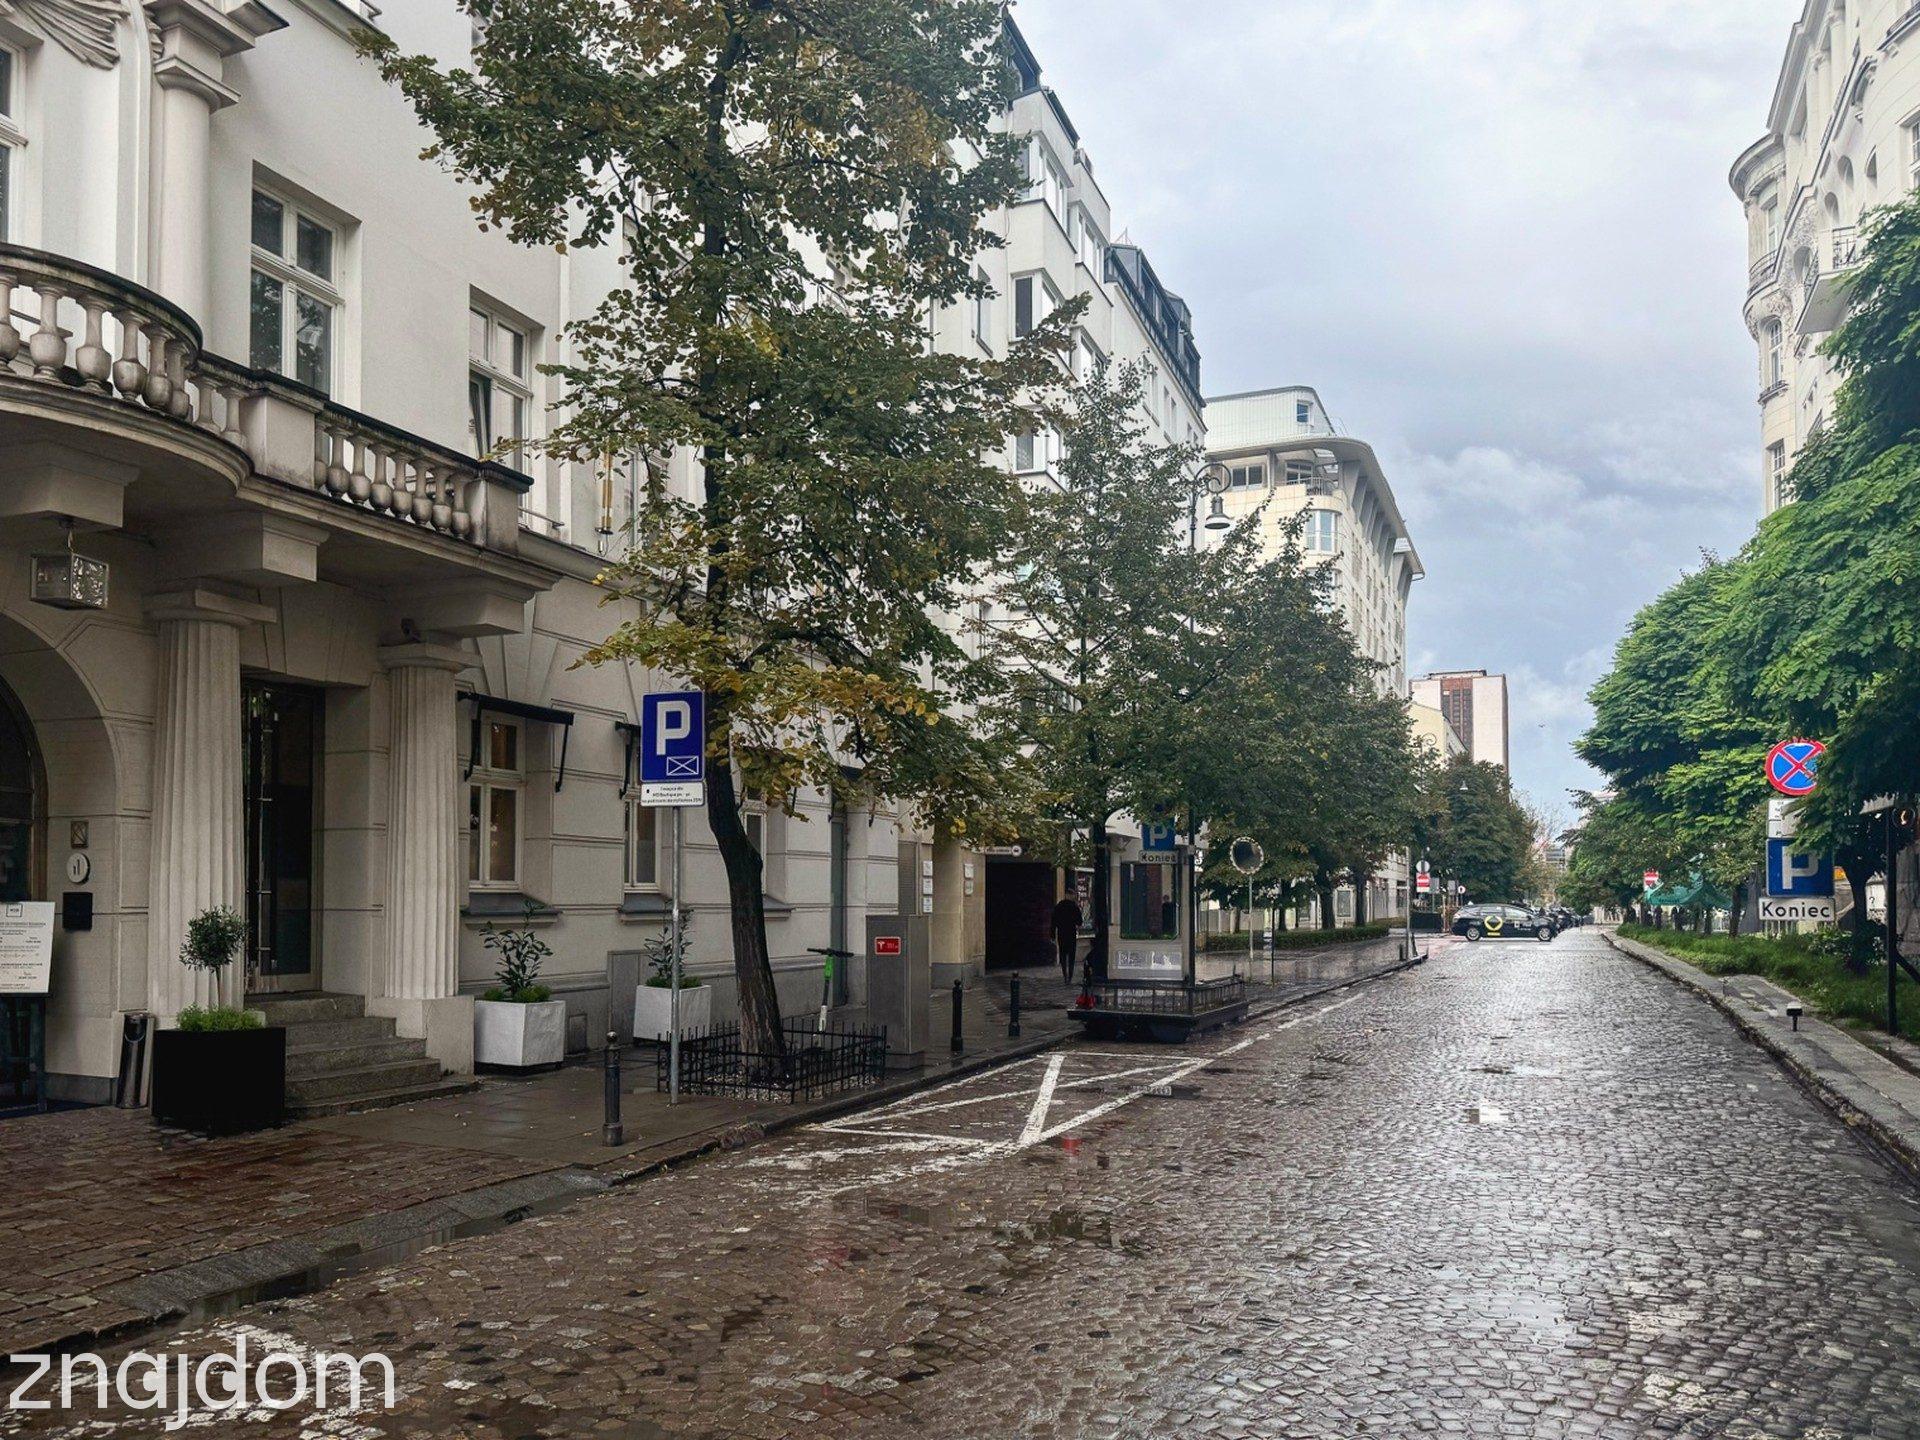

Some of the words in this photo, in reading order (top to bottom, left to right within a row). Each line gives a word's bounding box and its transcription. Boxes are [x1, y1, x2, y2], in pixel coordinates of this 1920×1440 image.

[656, 700, 691, 756] P
[1149, 823, 1168, 847] P
[1140, 851, 1177, 863] Koniec
[1781, 846, 1819, 890] P
[1761, 901, 1831, 919] Koniec
